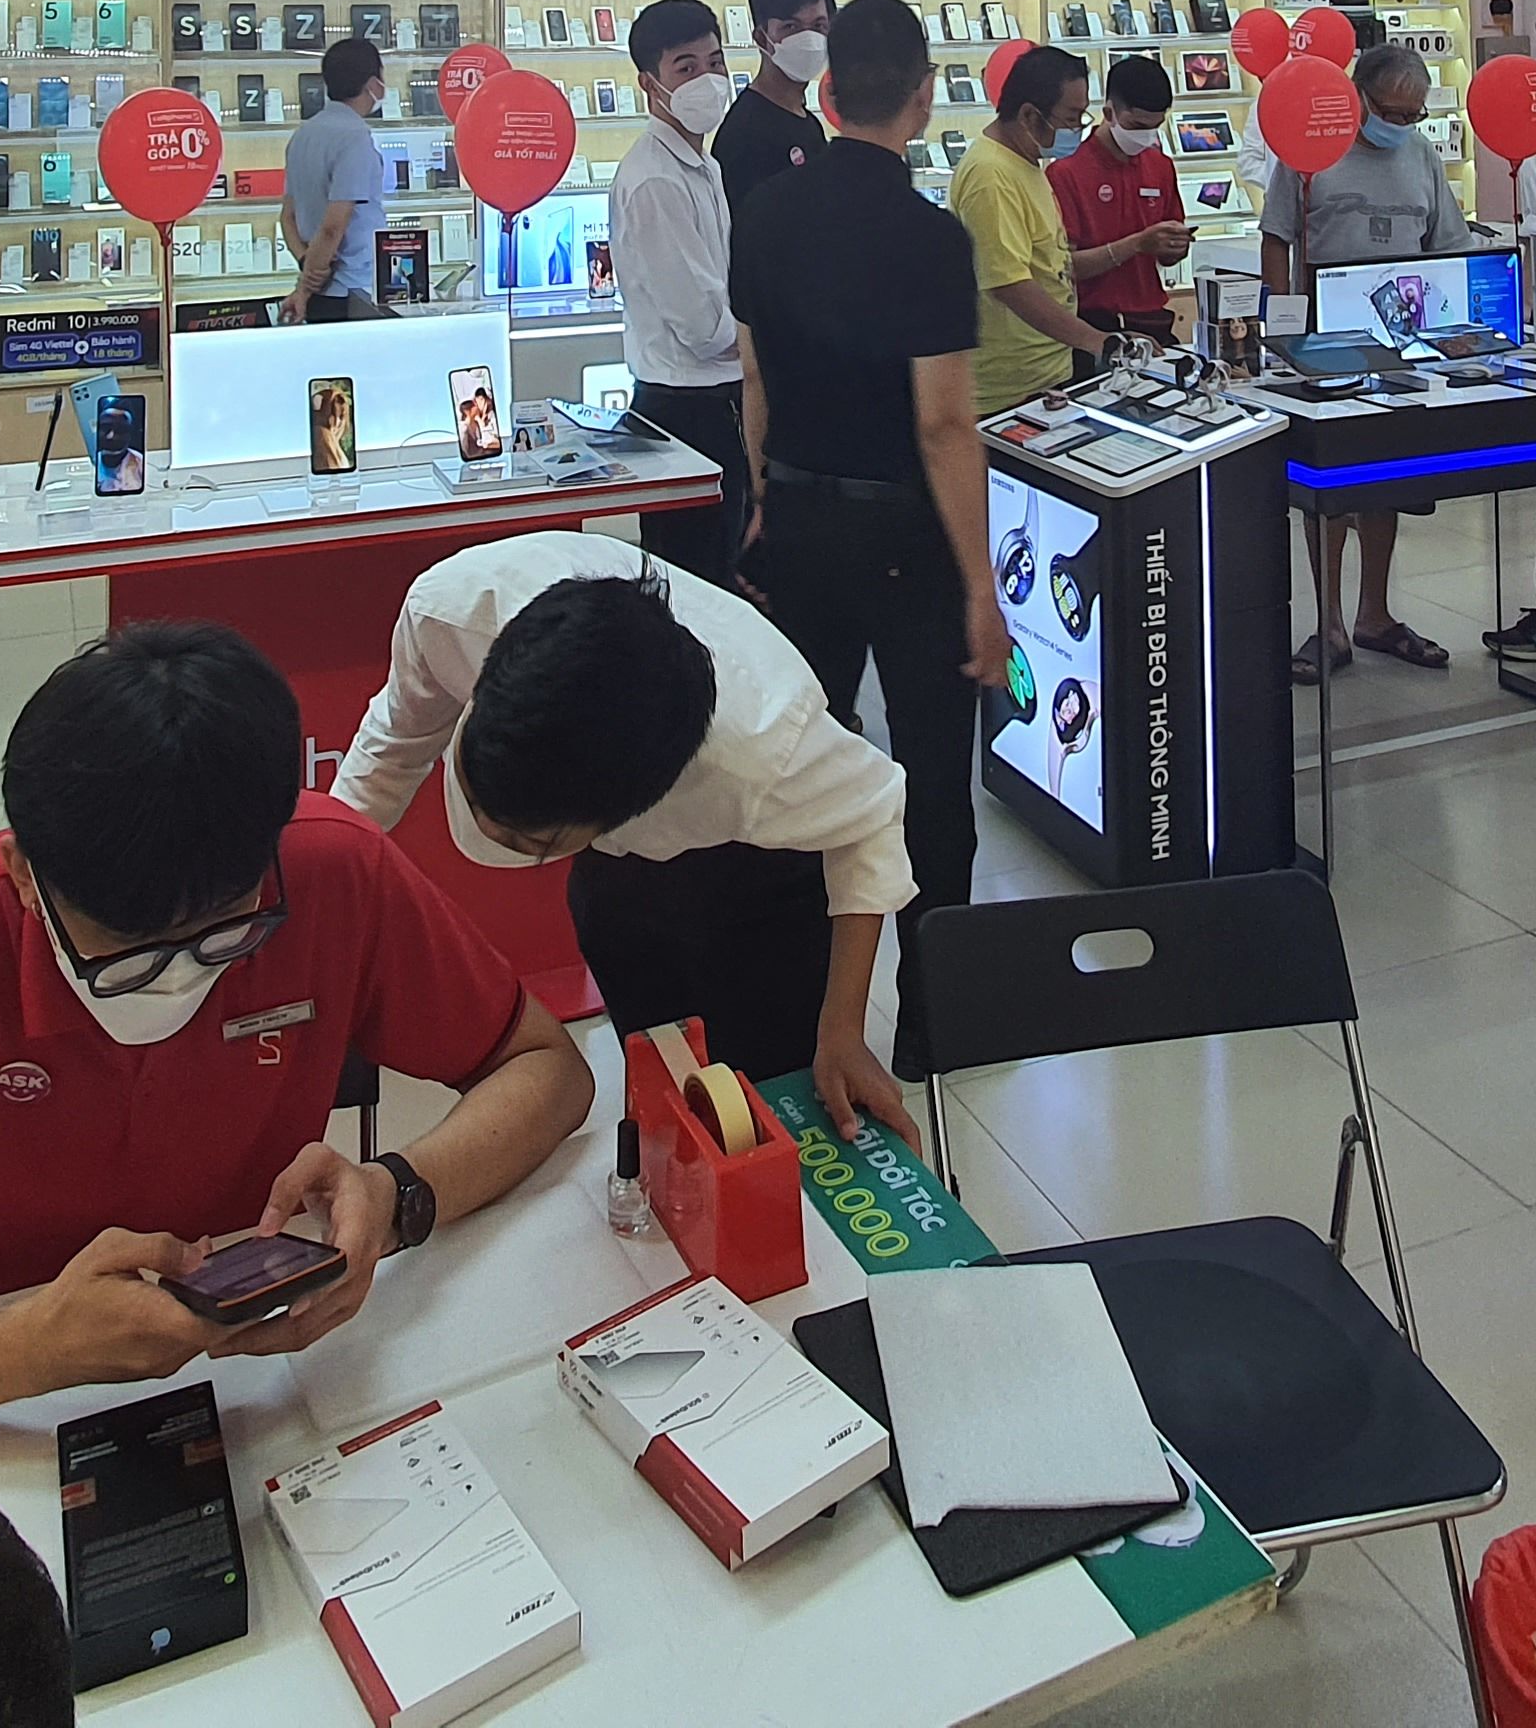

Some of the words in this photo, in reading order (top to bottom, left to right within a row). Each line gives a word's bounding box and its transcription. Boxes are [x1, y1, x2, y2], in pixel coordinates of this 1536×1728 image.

[44, 2, 58, 20] 5
[98, 2, 112, 20] 6
[179, 15, 196, 36] S
[235, 15, 252, 36] S
[295, 14, 315, 40] Z
[363, 14, 382, 40] Z
[245, 89, 259, 108] Z
[147, 129, 179, 146] TRẢ
[181, 128, 210, 159] 0%
[148, 145, 180, 160] GÓP
[494, 148, 513, 159] GIÁ
[515, 147, 533, 159] TỐT
[235, 172, 251, 195] 8T
[6, 317, 56, 332] Redmi
[68, 315, 84, 329] 10
[92, 315, 139, 326] 3.990.000
[9, 342, 28, 352] Sim
[44, 339, 74, 349] Viettel
[91, 336, 110, 346] Bảo
[112, 336, 136, 345] hành
[1145, 528, 1175, 597] THIẾT
[1141, 600, 1167, 629] BỊ
[1148, 632, 1167, 689] ĐEO
[1149, 692, 1169, 790] THÔNG
[1150, 793, 1170, 862] MINH
[778, 1095, 806, 1125] Giảm
[797, 1125, 909, 1258] 500.000
[865, 1146, 918, 1191] Đối
[900, 1186, 947, 1233] Tác
